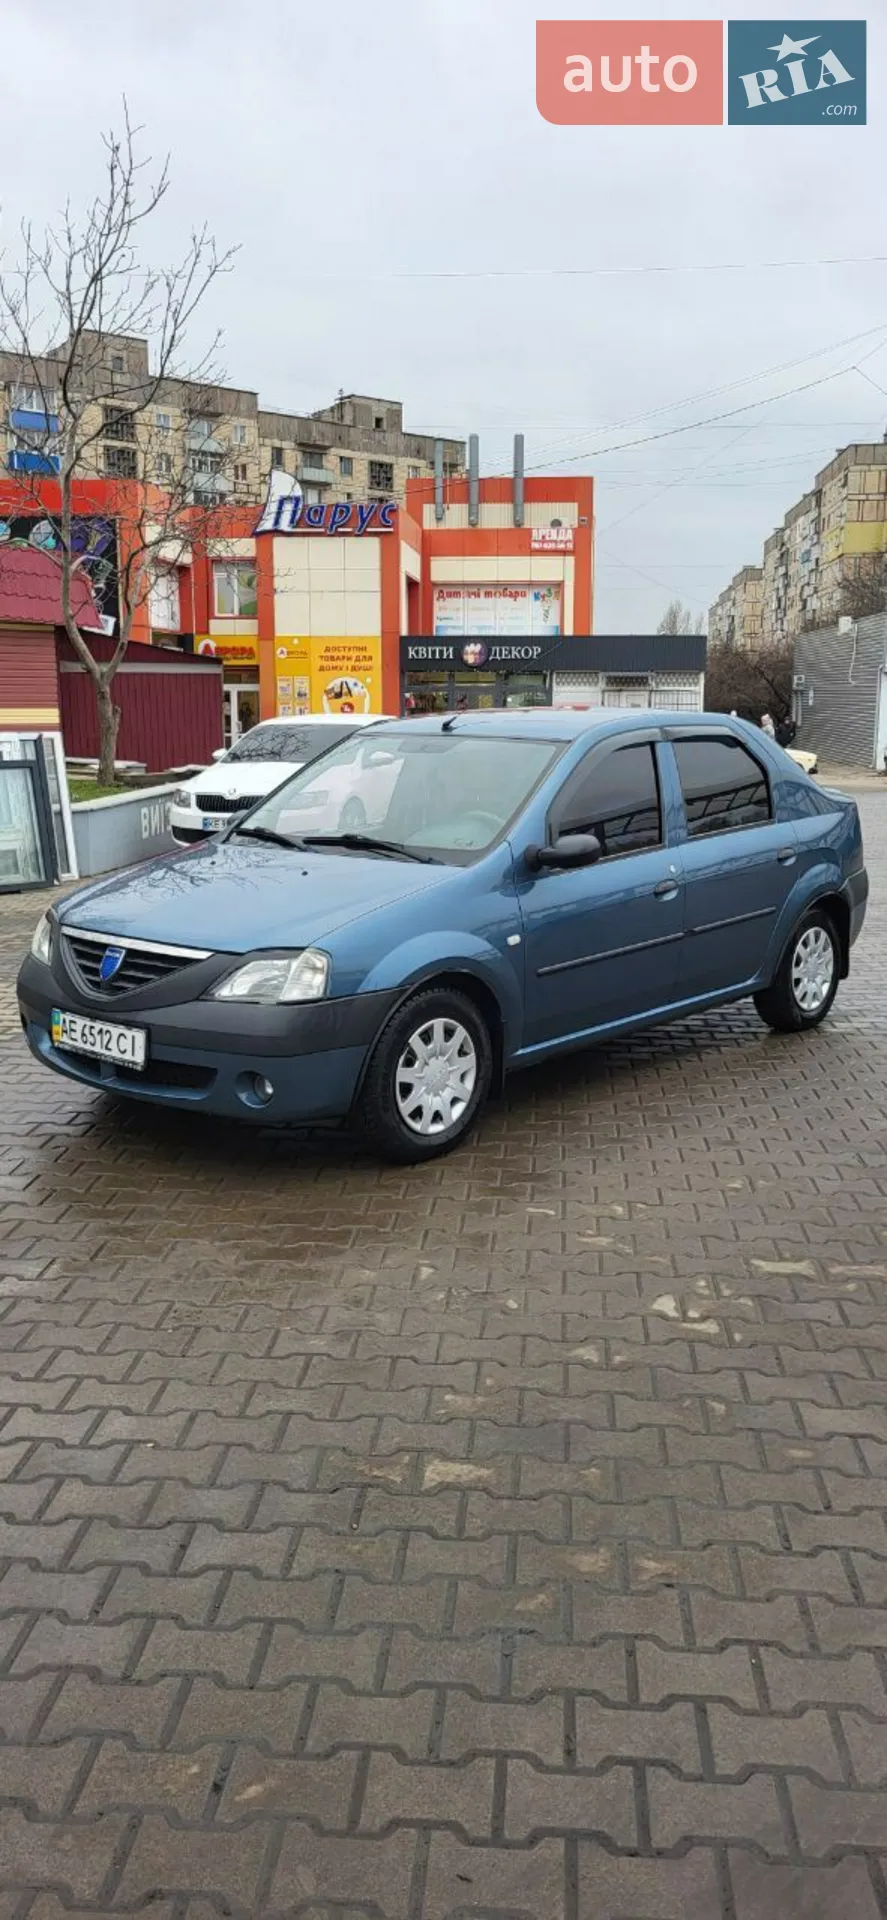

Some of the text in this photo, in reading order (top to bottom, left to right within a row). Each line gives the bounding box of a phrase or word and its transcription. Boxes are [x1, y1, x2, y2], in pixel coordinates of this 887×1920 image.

[272, 496, 397, 534] Парус
[531, 529, 574, 540] АРЕНДА
[324, 645, 367, 653] ДОСТУПНІ
[408, 646, 541, 660] КВІТИ ДЕКОР
[354, 655, 373, 663] ДЛЯ
[62, 1017, 78, 1042] AE
[81, 1023, 112, 1052] 6512
